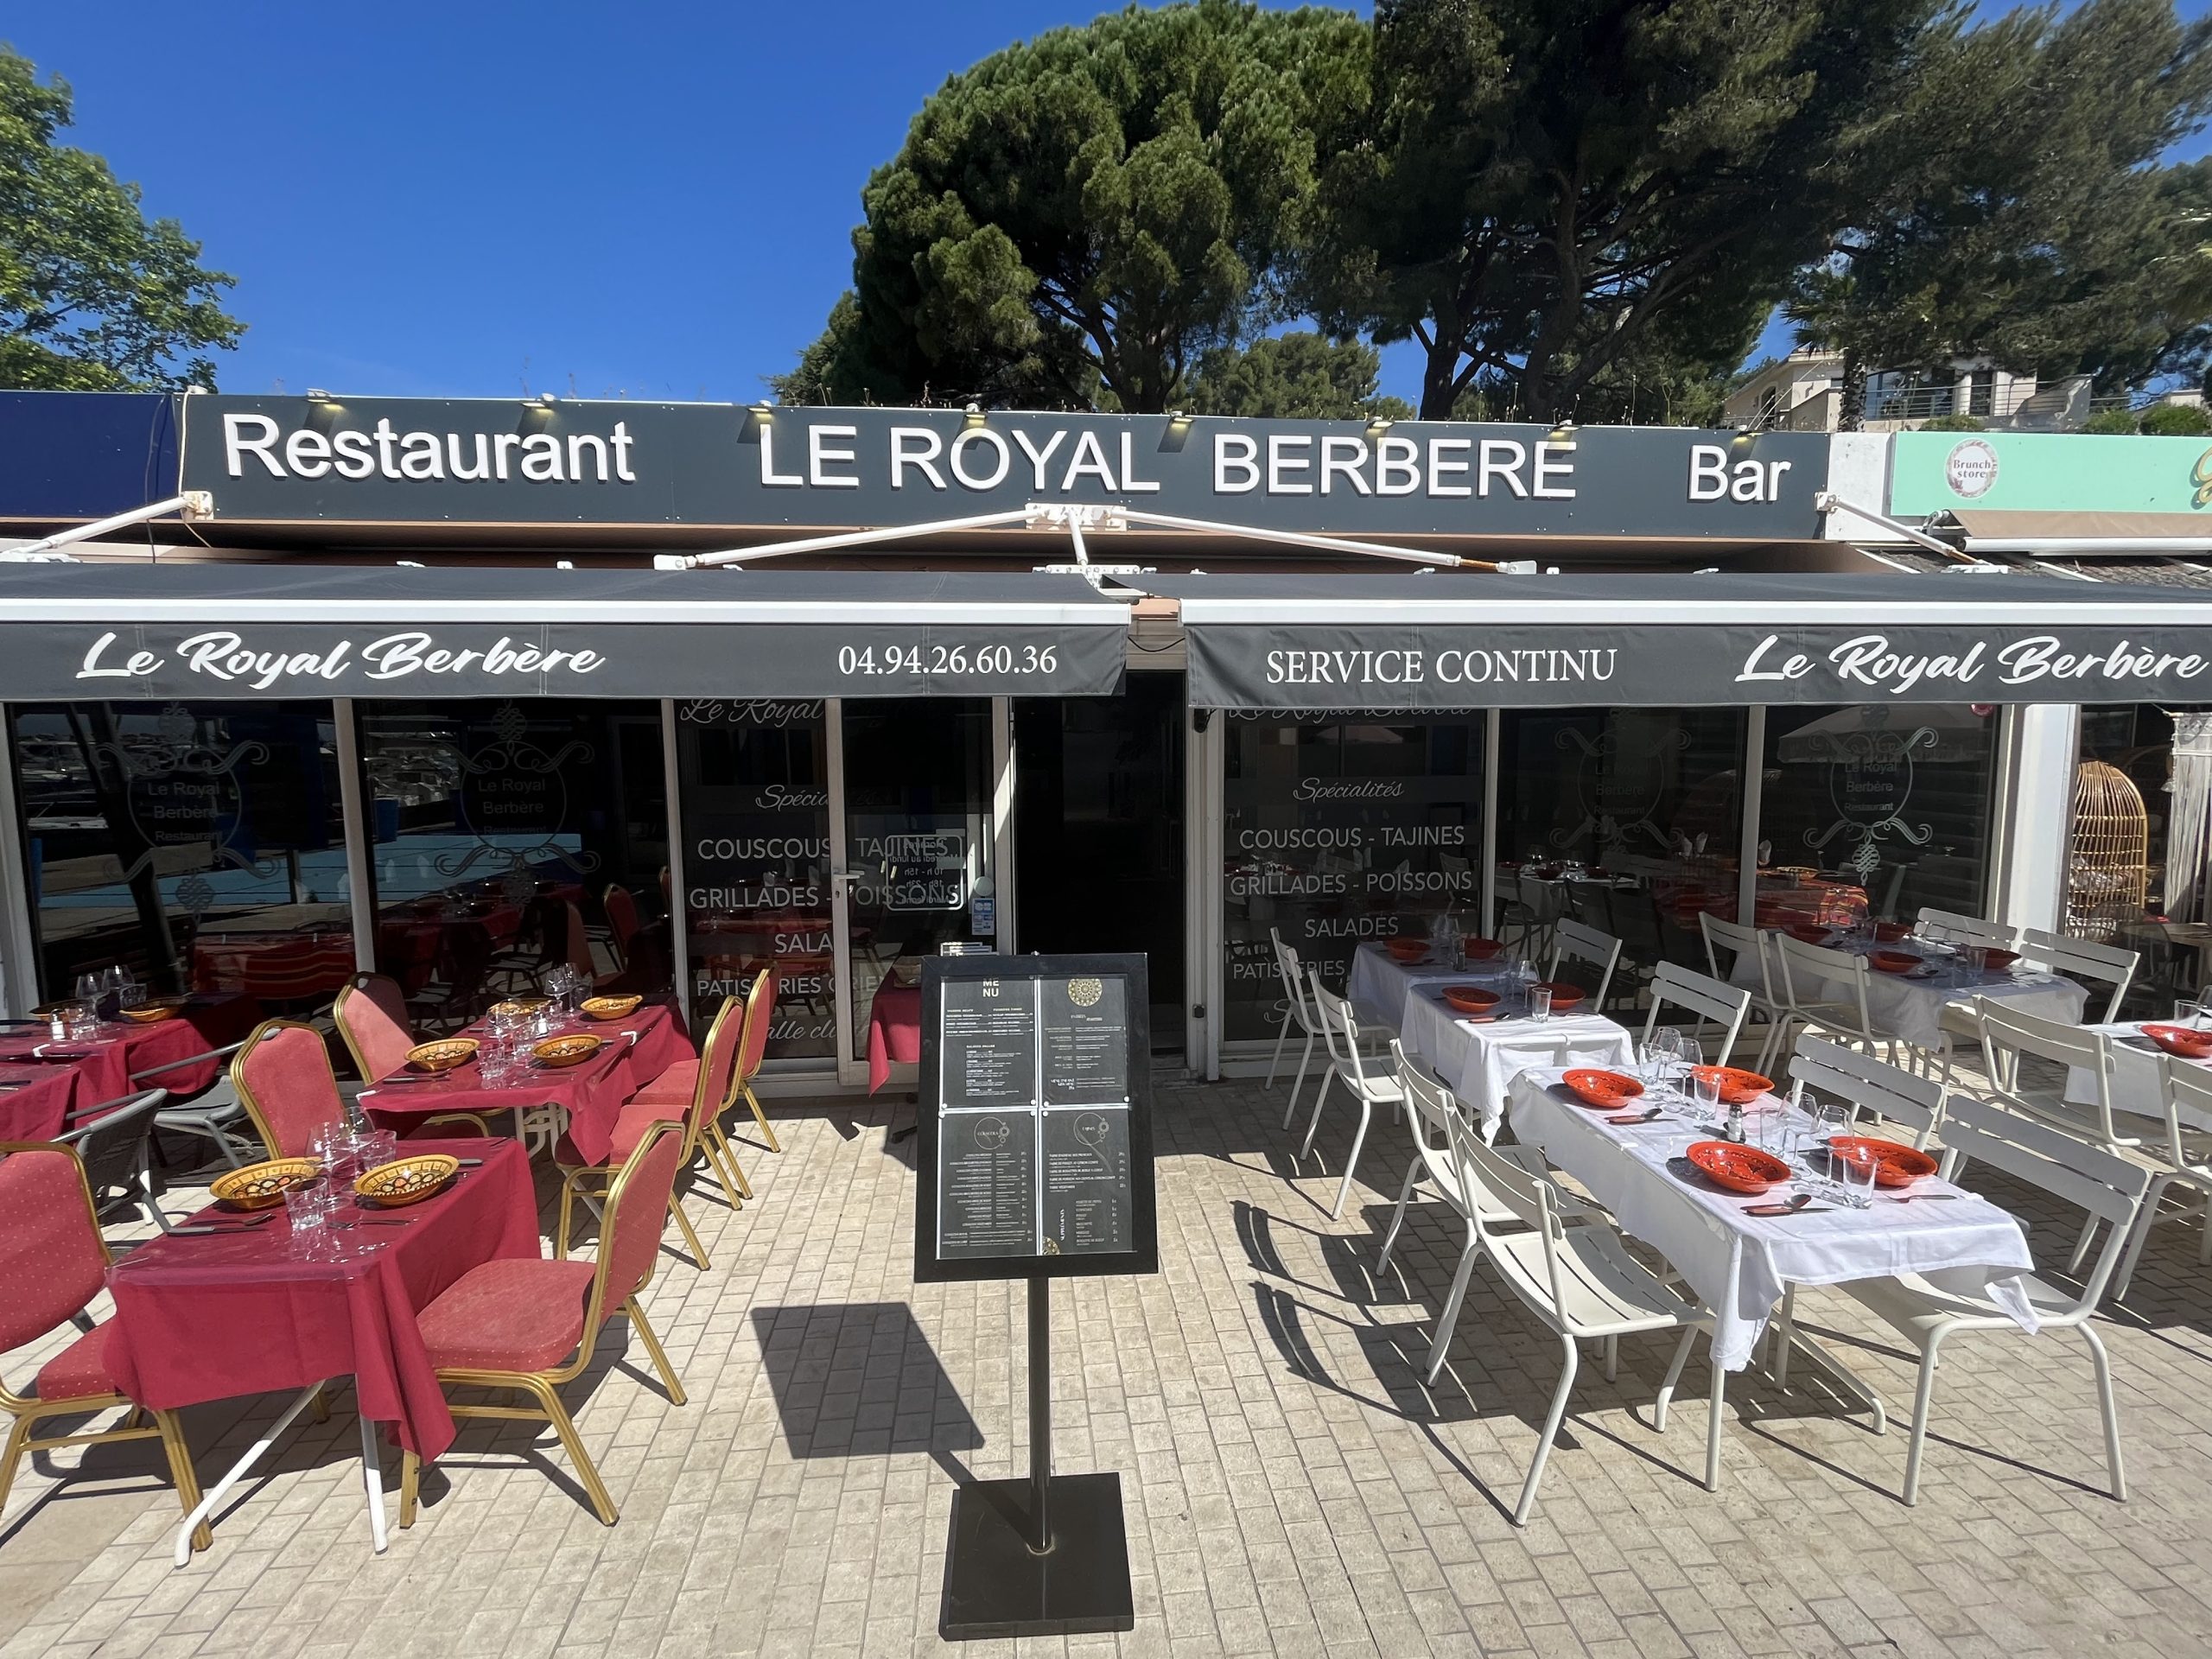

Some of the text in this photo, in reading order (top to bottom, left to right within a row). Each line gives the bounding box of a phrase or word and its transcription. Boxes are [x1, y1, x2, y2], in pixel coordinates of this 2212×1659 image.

[223, 413, 636, 484] Restaurant
[760, 423, 1578, 499] LE ROYAL BERBERE
[1688, 444, 1791, 503] Bar
[1953, 459, 1991, 470] Brunch
[1957, 470, 1986, 479] store
[76, 631, 607, 690] Le Royal Berbère
[838, 645, 1058, 677] 04.94.26.60.36
[1266, 647, 1618, 683] SERVICE CONTINU
[1735, 634, 2210, 694] Le Royal Berbère
[148, 781, 220, 798] Le Royal
[478, 778, 546, 794] Le Royal
[755, 785, 830, 812] Spécia
[1293, 777, 1404, 804] Spécialités
[697, 836, 830, 861] COUSCOUS
[1239, 827, 1362, 850] COUSCOUS
[1381, 824, 1465, 848] TAJINES
[1230, 874, 1346, 896] GRILLADES
[1366, 871, 1472, 893] POISSONS
[690, 887, 819, 909] GRILLADES
[854, 884, 959, 907] OISSONS
[1305, 916, 1399, 938] SALADES
[696, 977, 823, 997] PATISRIES
[982, 988, 999, 997] NU
[767, 1020, 805, 1040] alle
